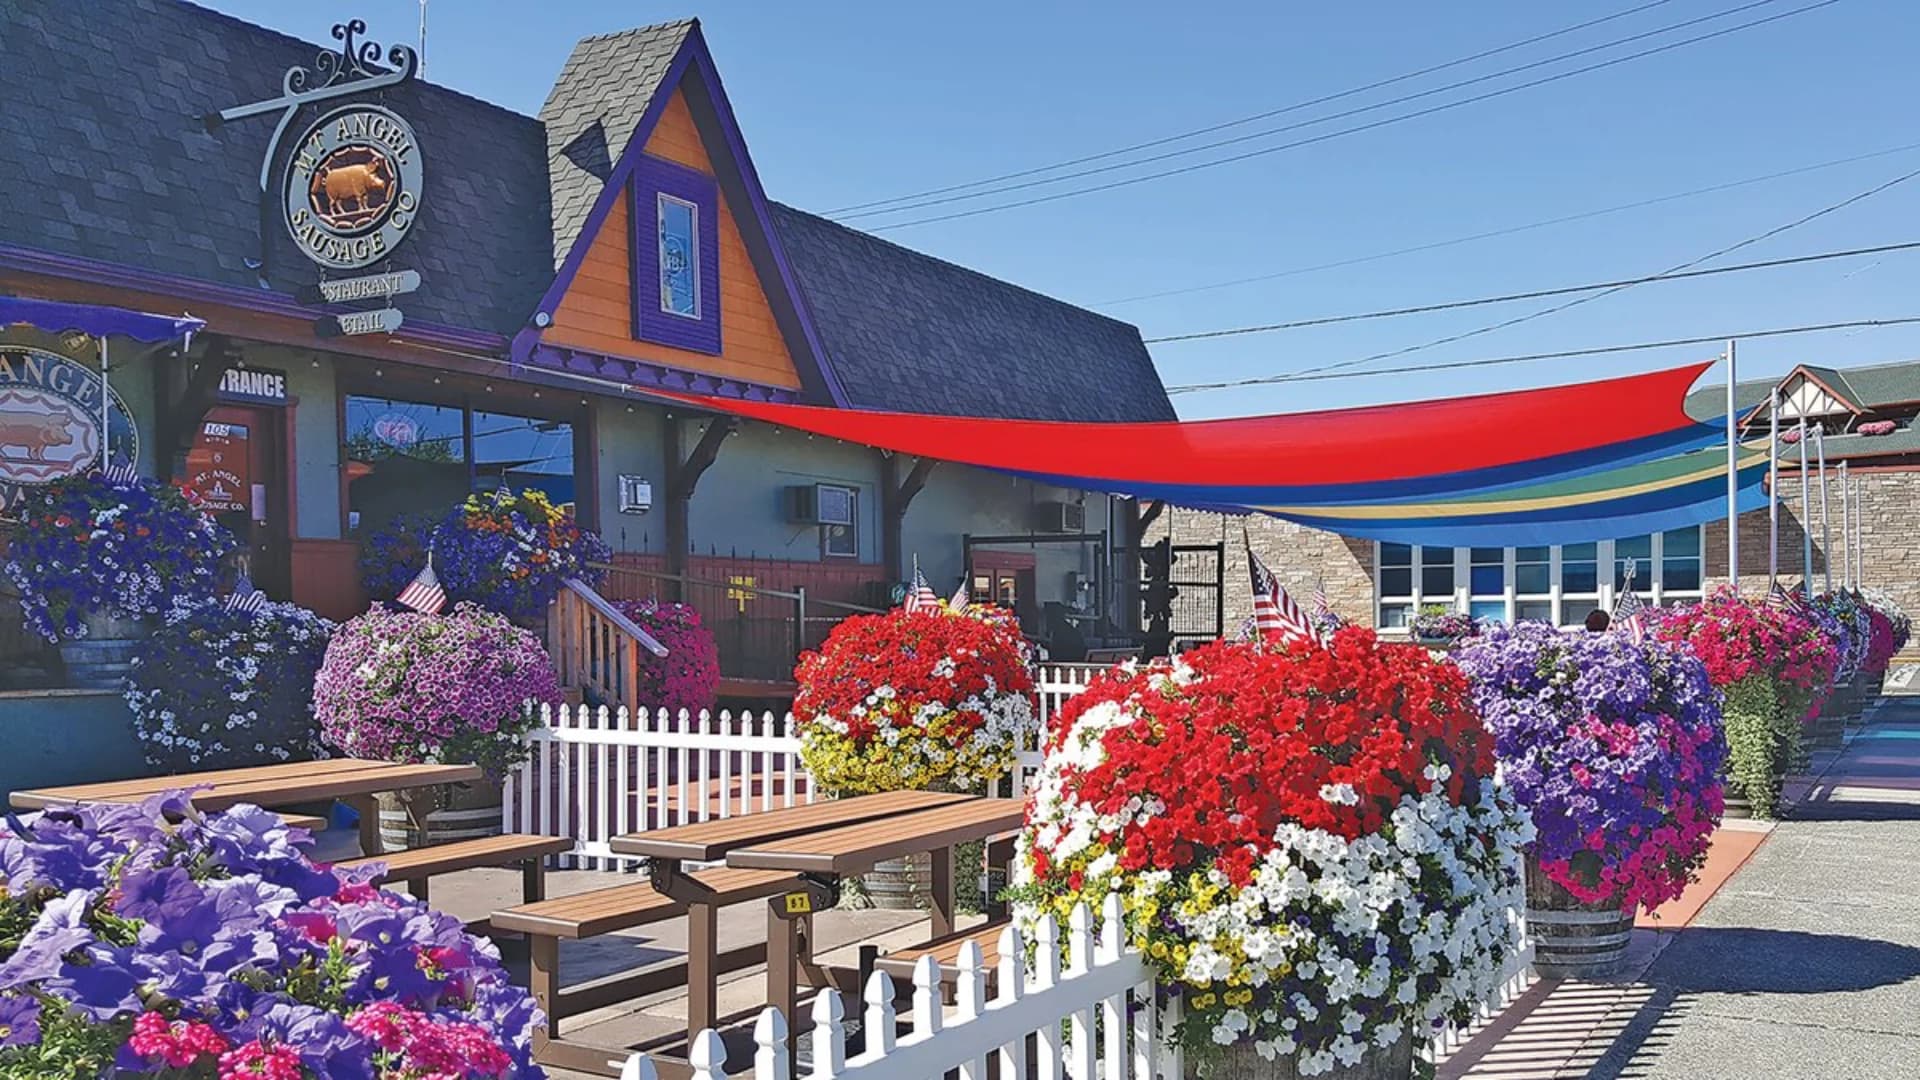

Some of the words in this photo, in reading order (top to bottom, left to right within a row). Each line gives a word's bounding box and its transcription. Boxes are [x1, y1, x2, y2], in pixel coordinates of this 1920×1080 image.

[294, 129, 328, 179] MT
[336, 113, 413, 165] ANGEL
[293, 207, 386, 262] SAUSAGE
[390, 191, 416, 231] CO
[341, 313, 384, 332] ETAIL
[207, 424, 228, 435] 105
[212, 469, 241, 488] ANGEL
